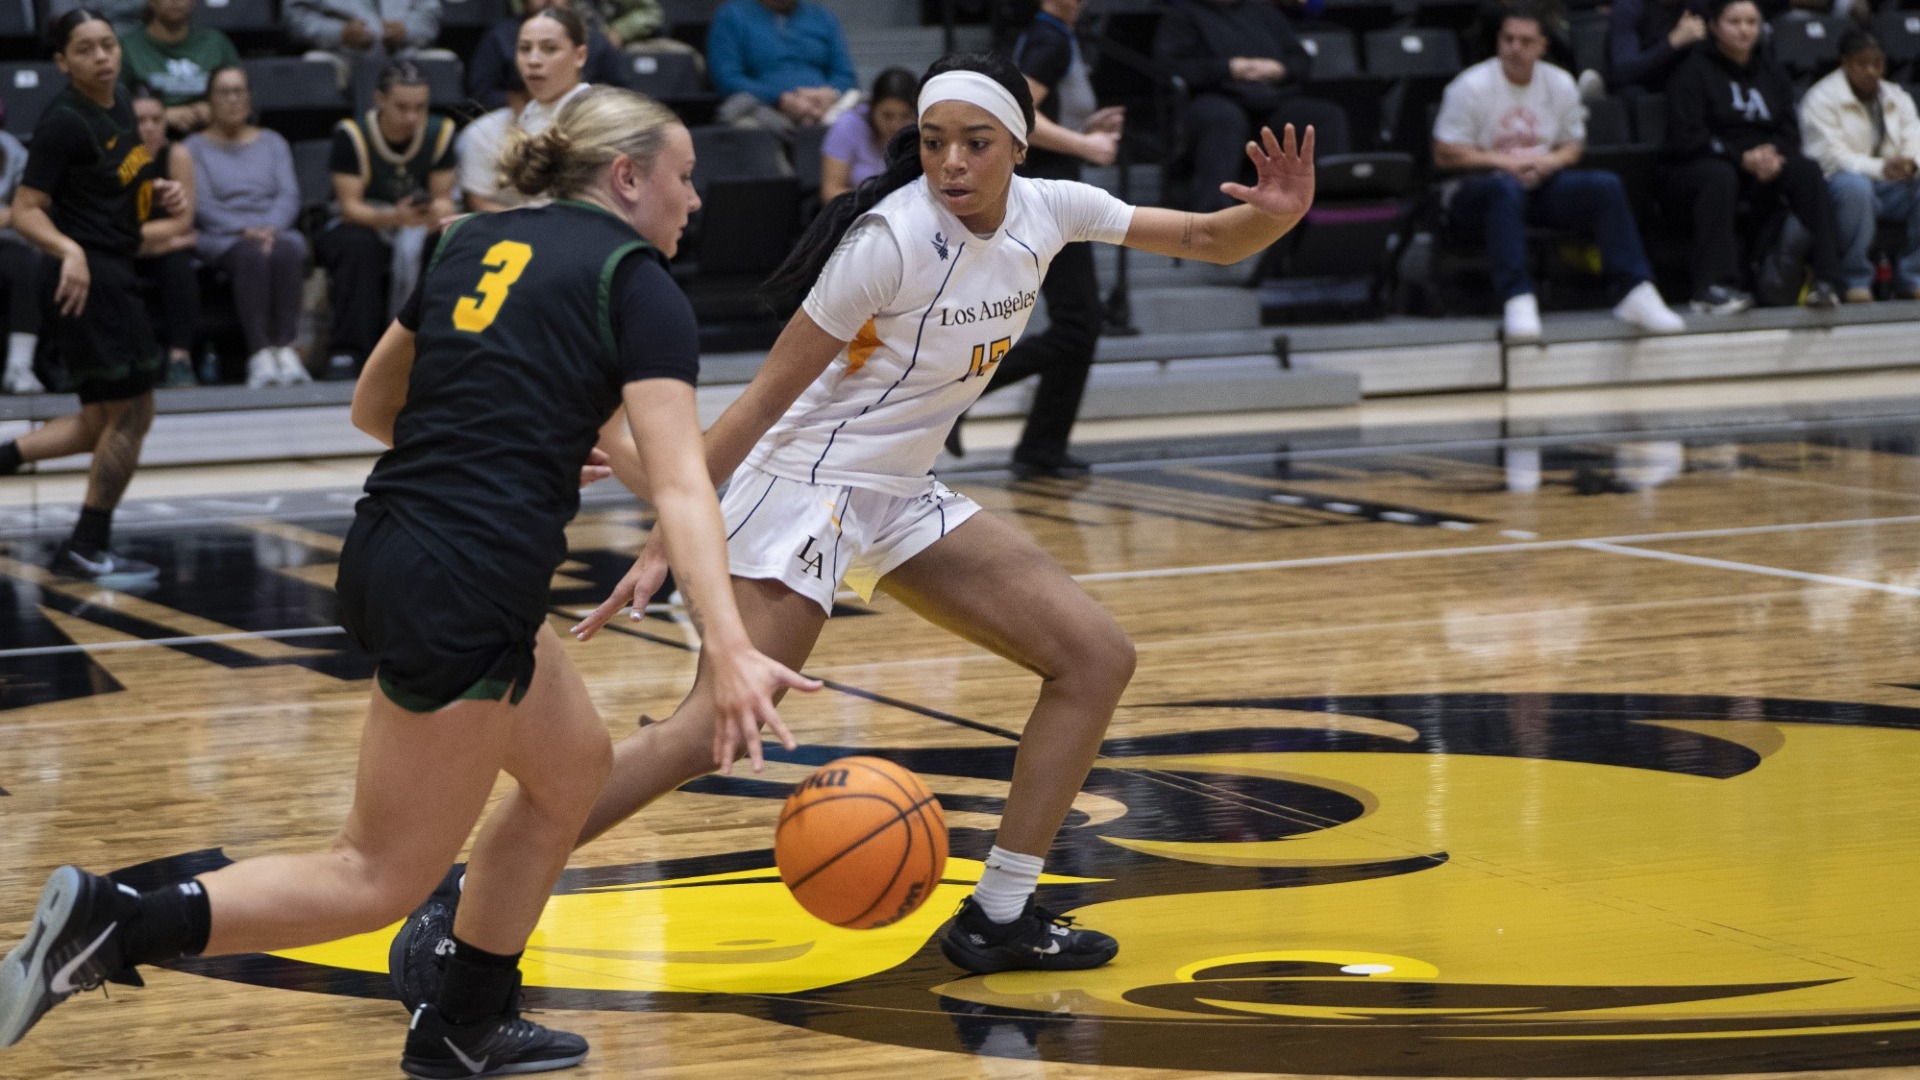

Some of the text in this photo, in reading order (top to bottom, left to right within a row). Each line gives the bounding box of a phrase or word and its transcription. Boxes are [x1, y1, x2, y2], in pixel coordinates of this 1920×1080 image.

[1729, 80, 1771, 121] LA
[452, 239, 533, 333] 3
[940, 289, 1036, 326] Los Angeles
[796, 534, 823, 580] LA
